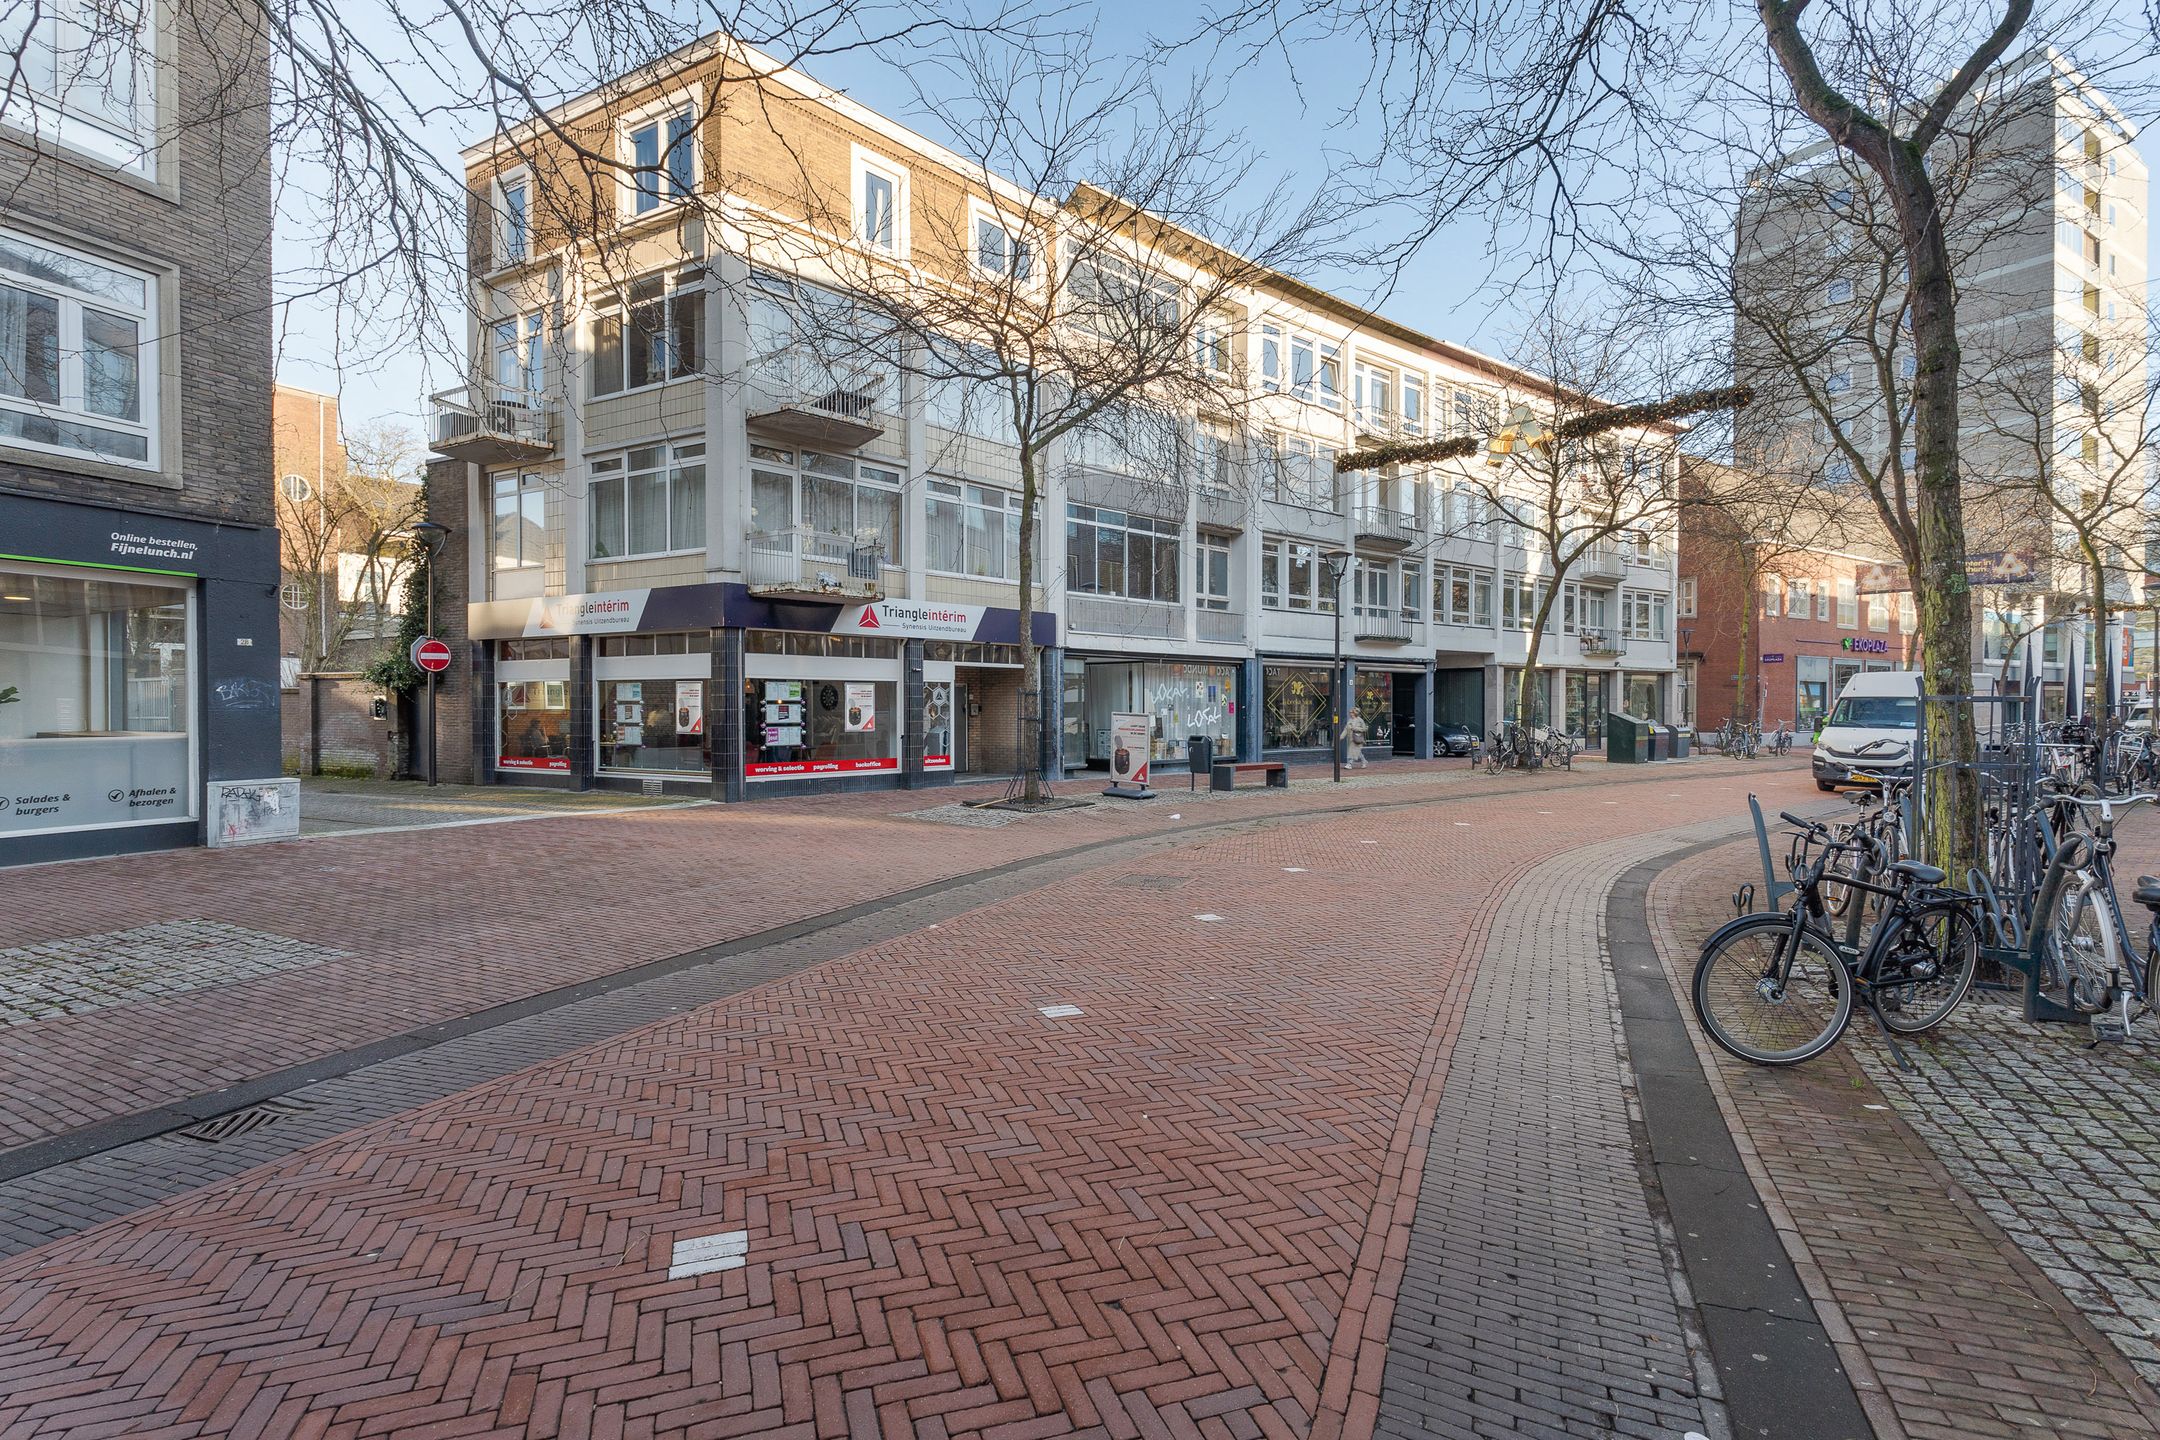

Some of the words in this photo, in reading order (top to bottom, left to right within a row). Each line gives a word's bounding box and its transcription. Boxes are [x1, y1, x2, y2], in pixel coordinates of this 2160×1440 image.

[111, 532, 147, 544] Online
[148, 536, 198, 551] bestellen,
[110, 542, 194, 560] Fijnelunch.nl
[882, 605, 967, 623] Triangleintérim
[902, 622, 927, 631] Synensis
[928, 625, 967, 633] Uitzendbureau
[1854, 638, 1889, 653] EKOPLAZA
[1187, 706, 1222, 728] LOCAL
[15, 794, 59, 805] Salades
[62, 793, 71, 801] &
[128, 788, 167, 798] Afhalen
[169, 787, 177, 795] &
[128, 796, 174, 807] bezorgen
[15, 804, 60, 816] burgers
